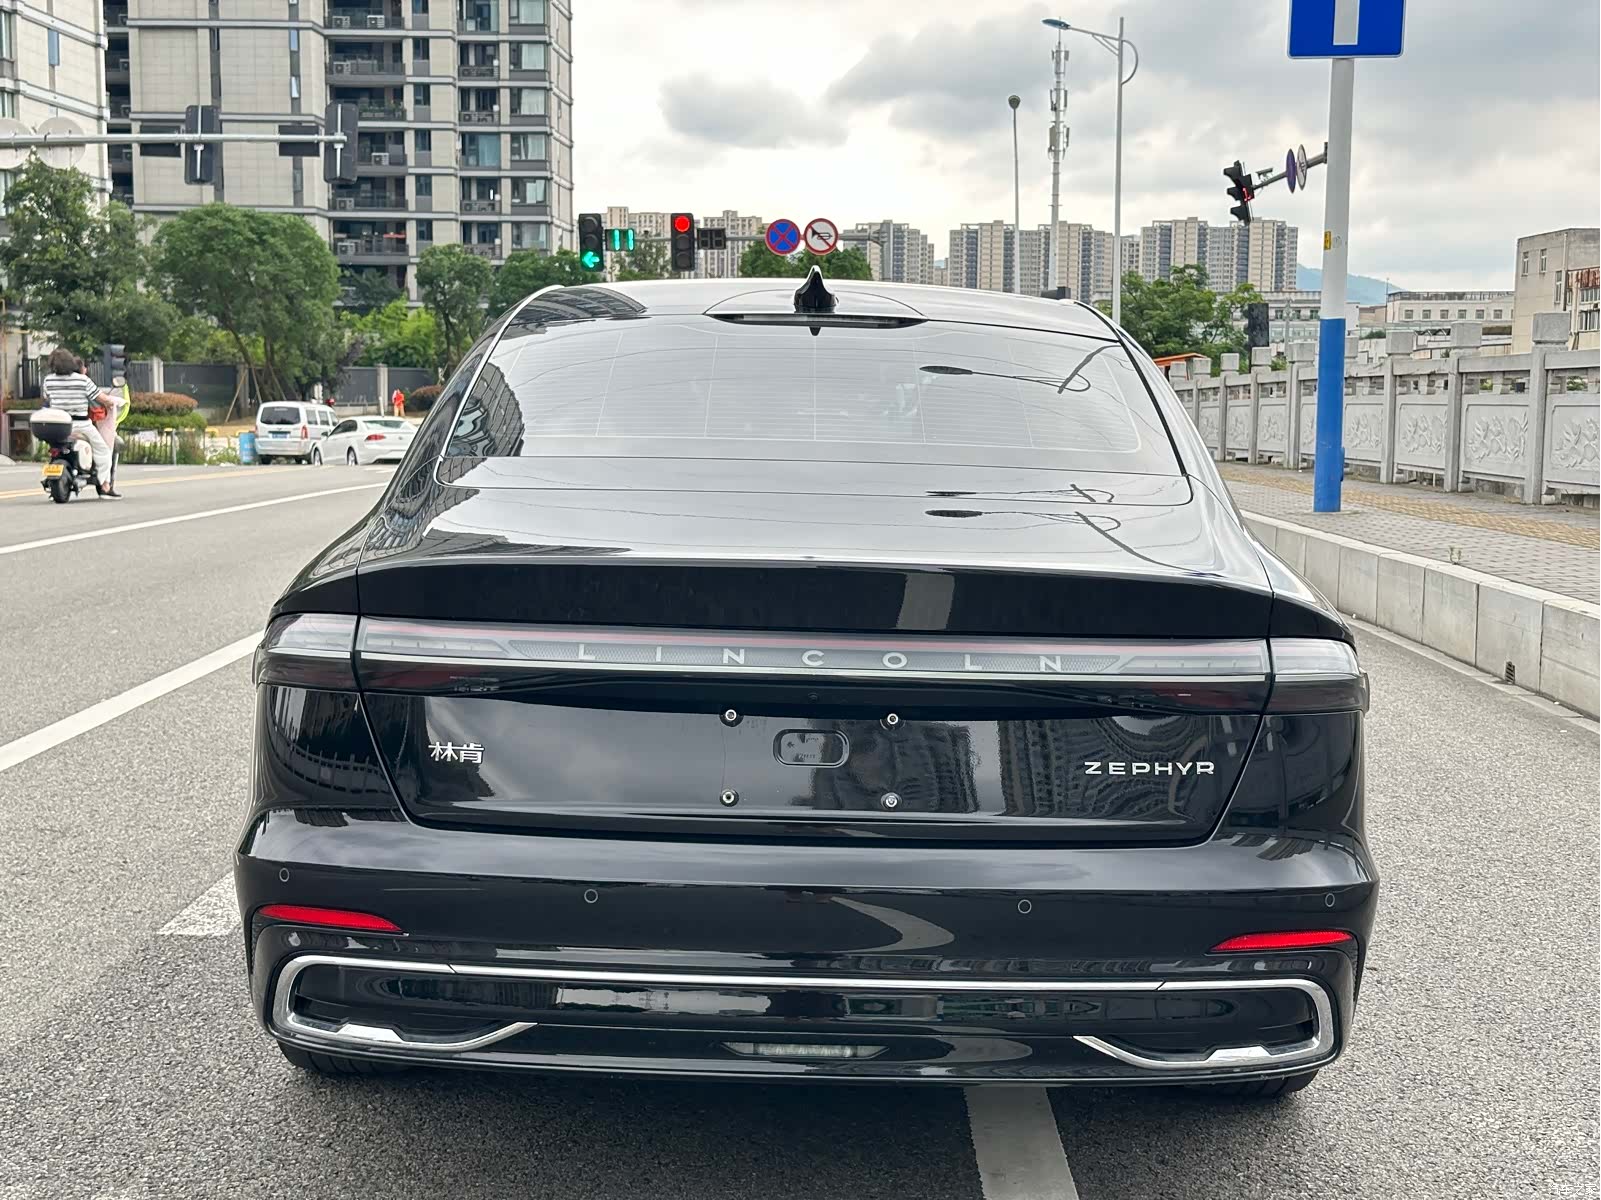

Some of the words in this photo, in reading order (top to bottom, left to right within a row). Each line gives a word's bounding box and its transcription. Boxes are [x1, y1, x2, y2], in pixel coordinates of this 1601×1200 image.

[578, 643, 1062, 672] LINCOLN
[428, 741, 485, 764] 林肯
[1084, 761, 1215, 776] ZEPHYR
